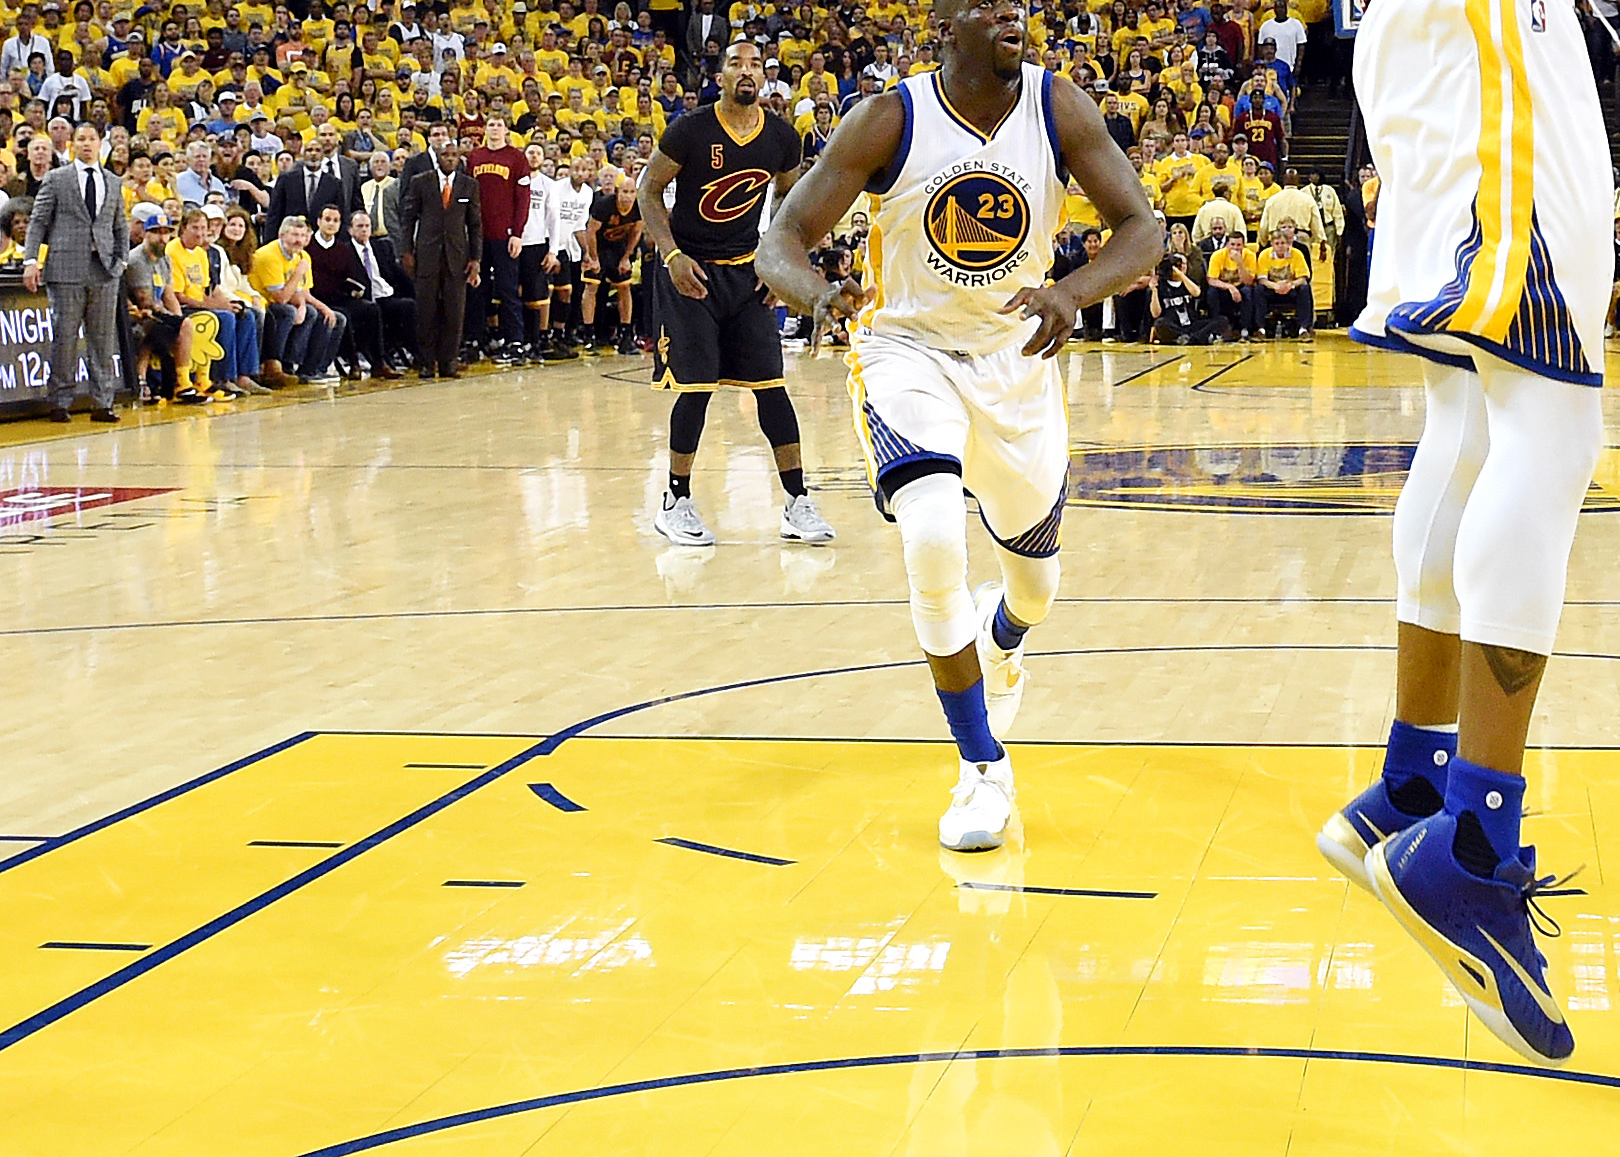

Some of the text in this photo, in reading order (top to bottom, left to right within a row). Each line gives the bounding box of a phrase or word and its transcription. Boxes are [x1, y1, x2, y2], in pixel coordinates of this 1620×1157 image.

[711, 144, 724, 170] 5
[924, 160, 1033, 195] GOLDEN STATE
[976, 192, 1015, 219] 23
[926, 249, 1030, 288] WARRIORS
[0, 307, 54, 346] NIGH
